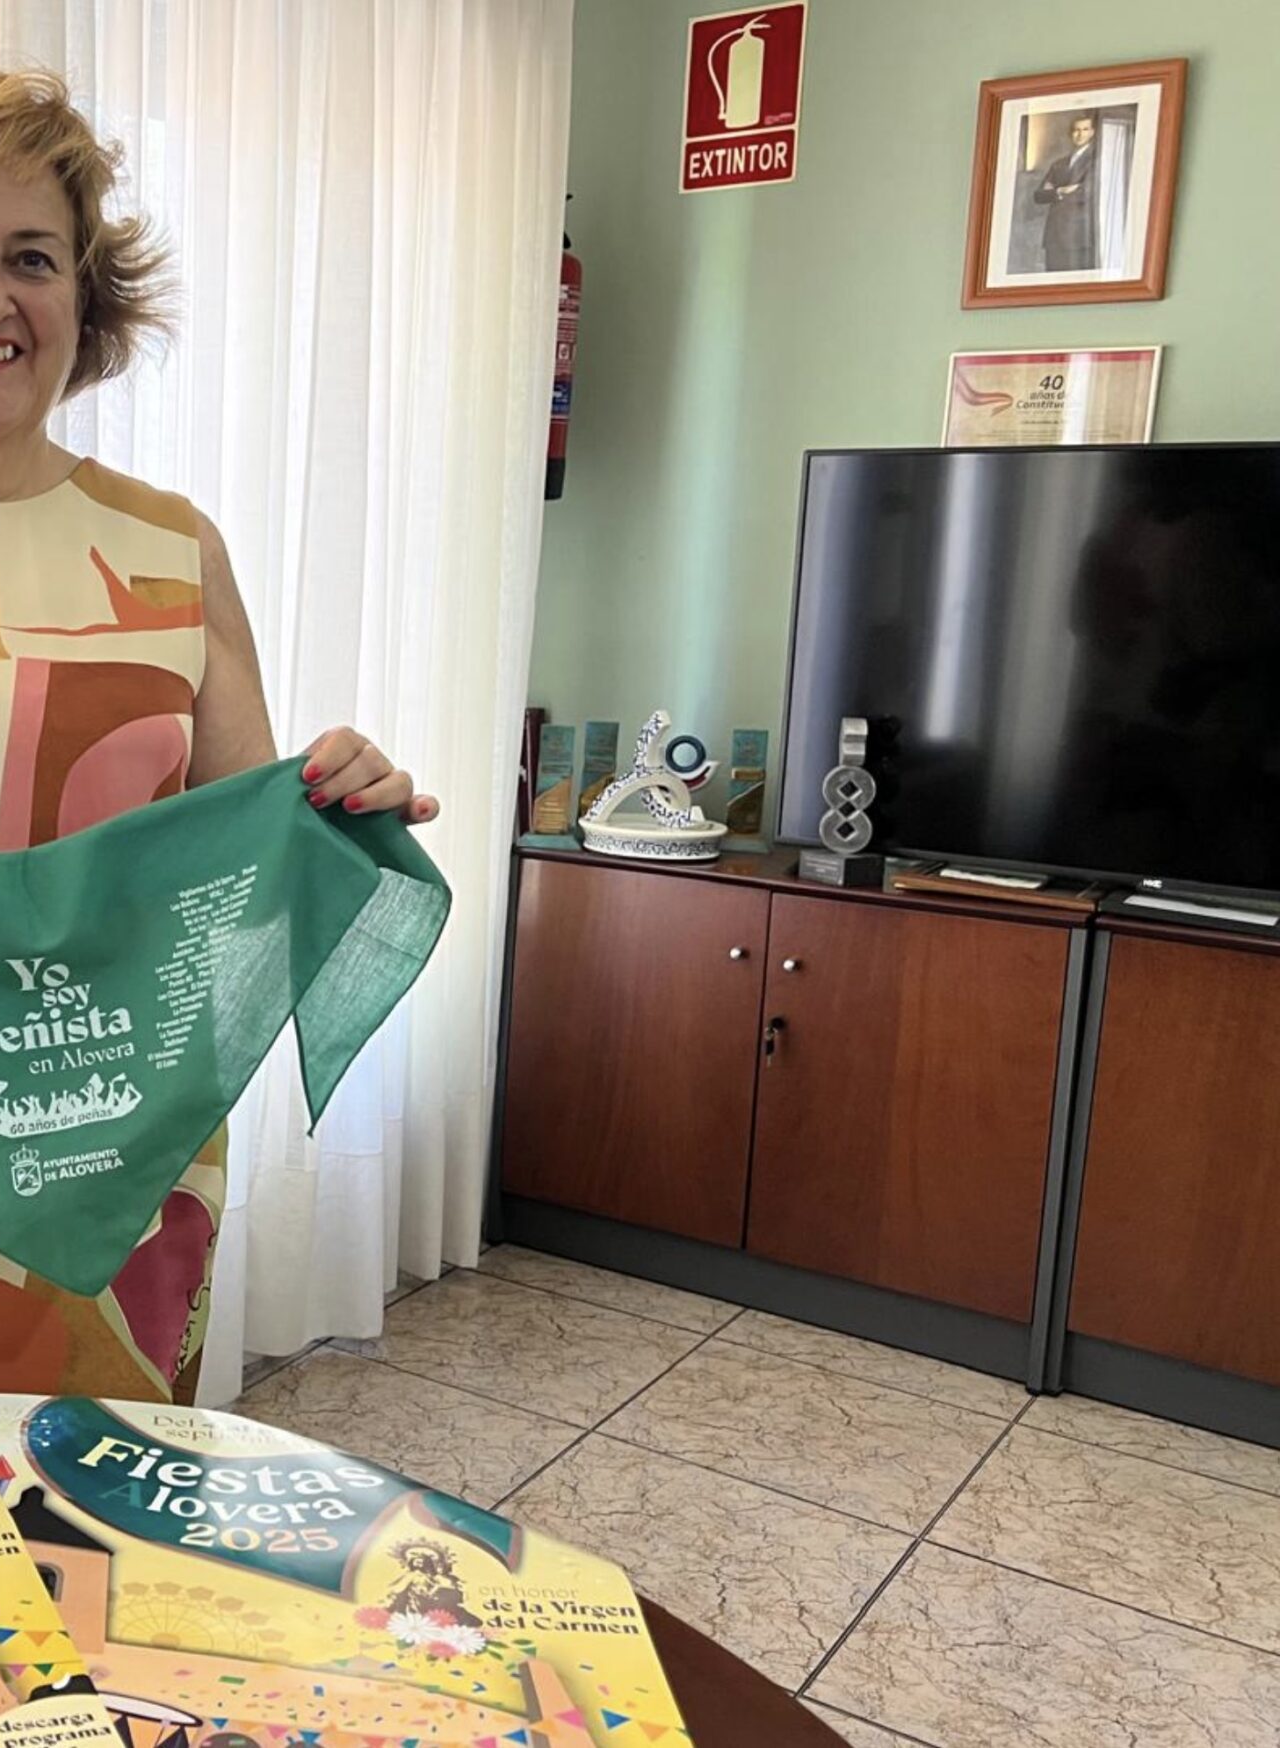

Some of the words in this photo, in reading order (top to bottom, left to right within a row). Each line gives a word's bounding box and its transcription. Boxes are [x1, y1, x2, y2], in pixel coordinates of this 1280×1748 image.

[689, 141, 787, 179] EXTINTOR
[1039, 374, 1065, 391] 40
[5, 957, 70, 991] Yo
[42, 983, 91, 1010] soy
[28, 1057, 54, 1074] en
[60, 1042, 135, 1070] Alovera
[10, 1122, 25, 1135] 60
[28, 1117, 58, 1133] años
[61, 1114, 75, 1127] de
[78, 1106, 113, 1124] peñas
[43, 1148, 119, 1169] AYUNTAMIENTO
[44, 1171, 57, 1182] DE
[59, 1158, 124, 1179] ALOVERA
[153, 1415, 194, 1429] Del
[77, 1436, 386, 1496] Fiestas
[103, 1480, 356, 1525] Alovera
[180, 1523, 340, 1553] 2025
[479, 1586, 506, 1597] en
[513, 1584, 579, 1598] honor
[482, 1599, 513, 1613] de
[519, 1599, 544, 1614] la
[548, 1600, 636, 1620] Virgen
[486, 1616, 526, 1630] del
[534, 1617, 640, 1635] Carmen
[3, 1726, 112, 1748] programa
